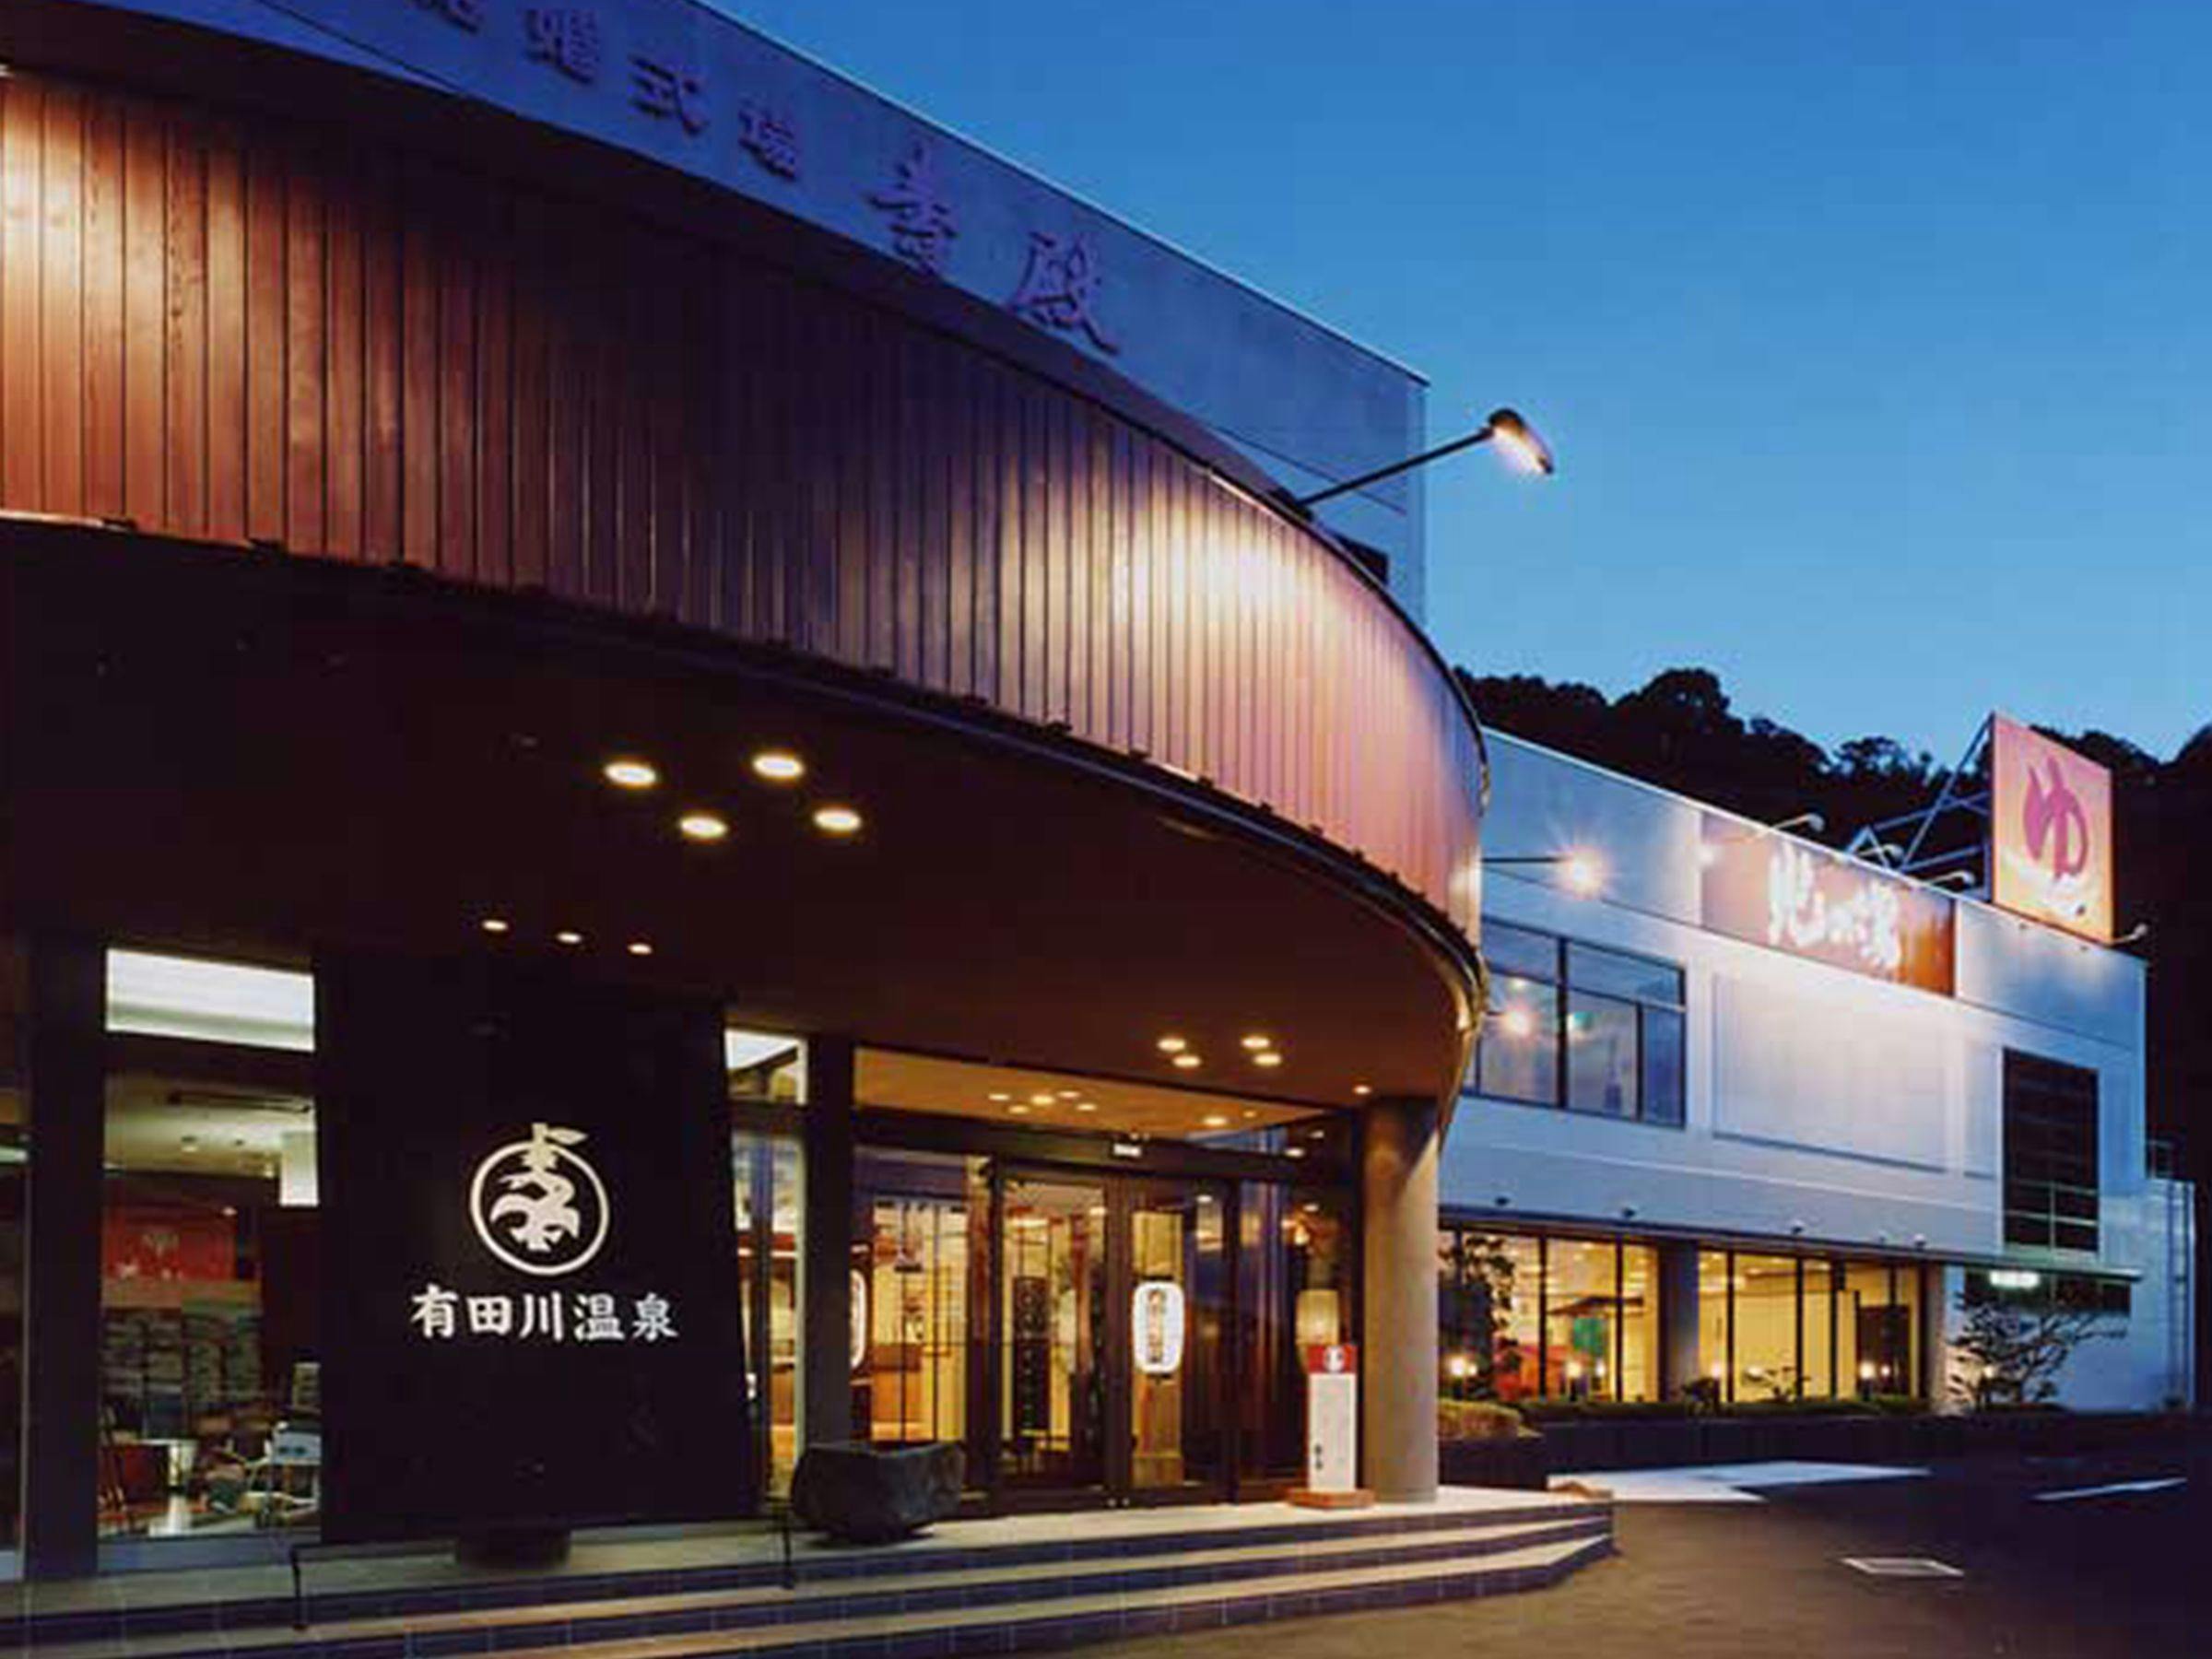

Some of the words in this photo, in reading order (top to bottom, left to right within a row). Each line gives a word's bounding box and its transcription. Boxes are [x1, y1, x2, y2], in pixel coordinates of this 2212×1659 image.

[2023, 756, 2089, 882] ゆ
[410, 1283, 679, 1342] 有田川温泉
